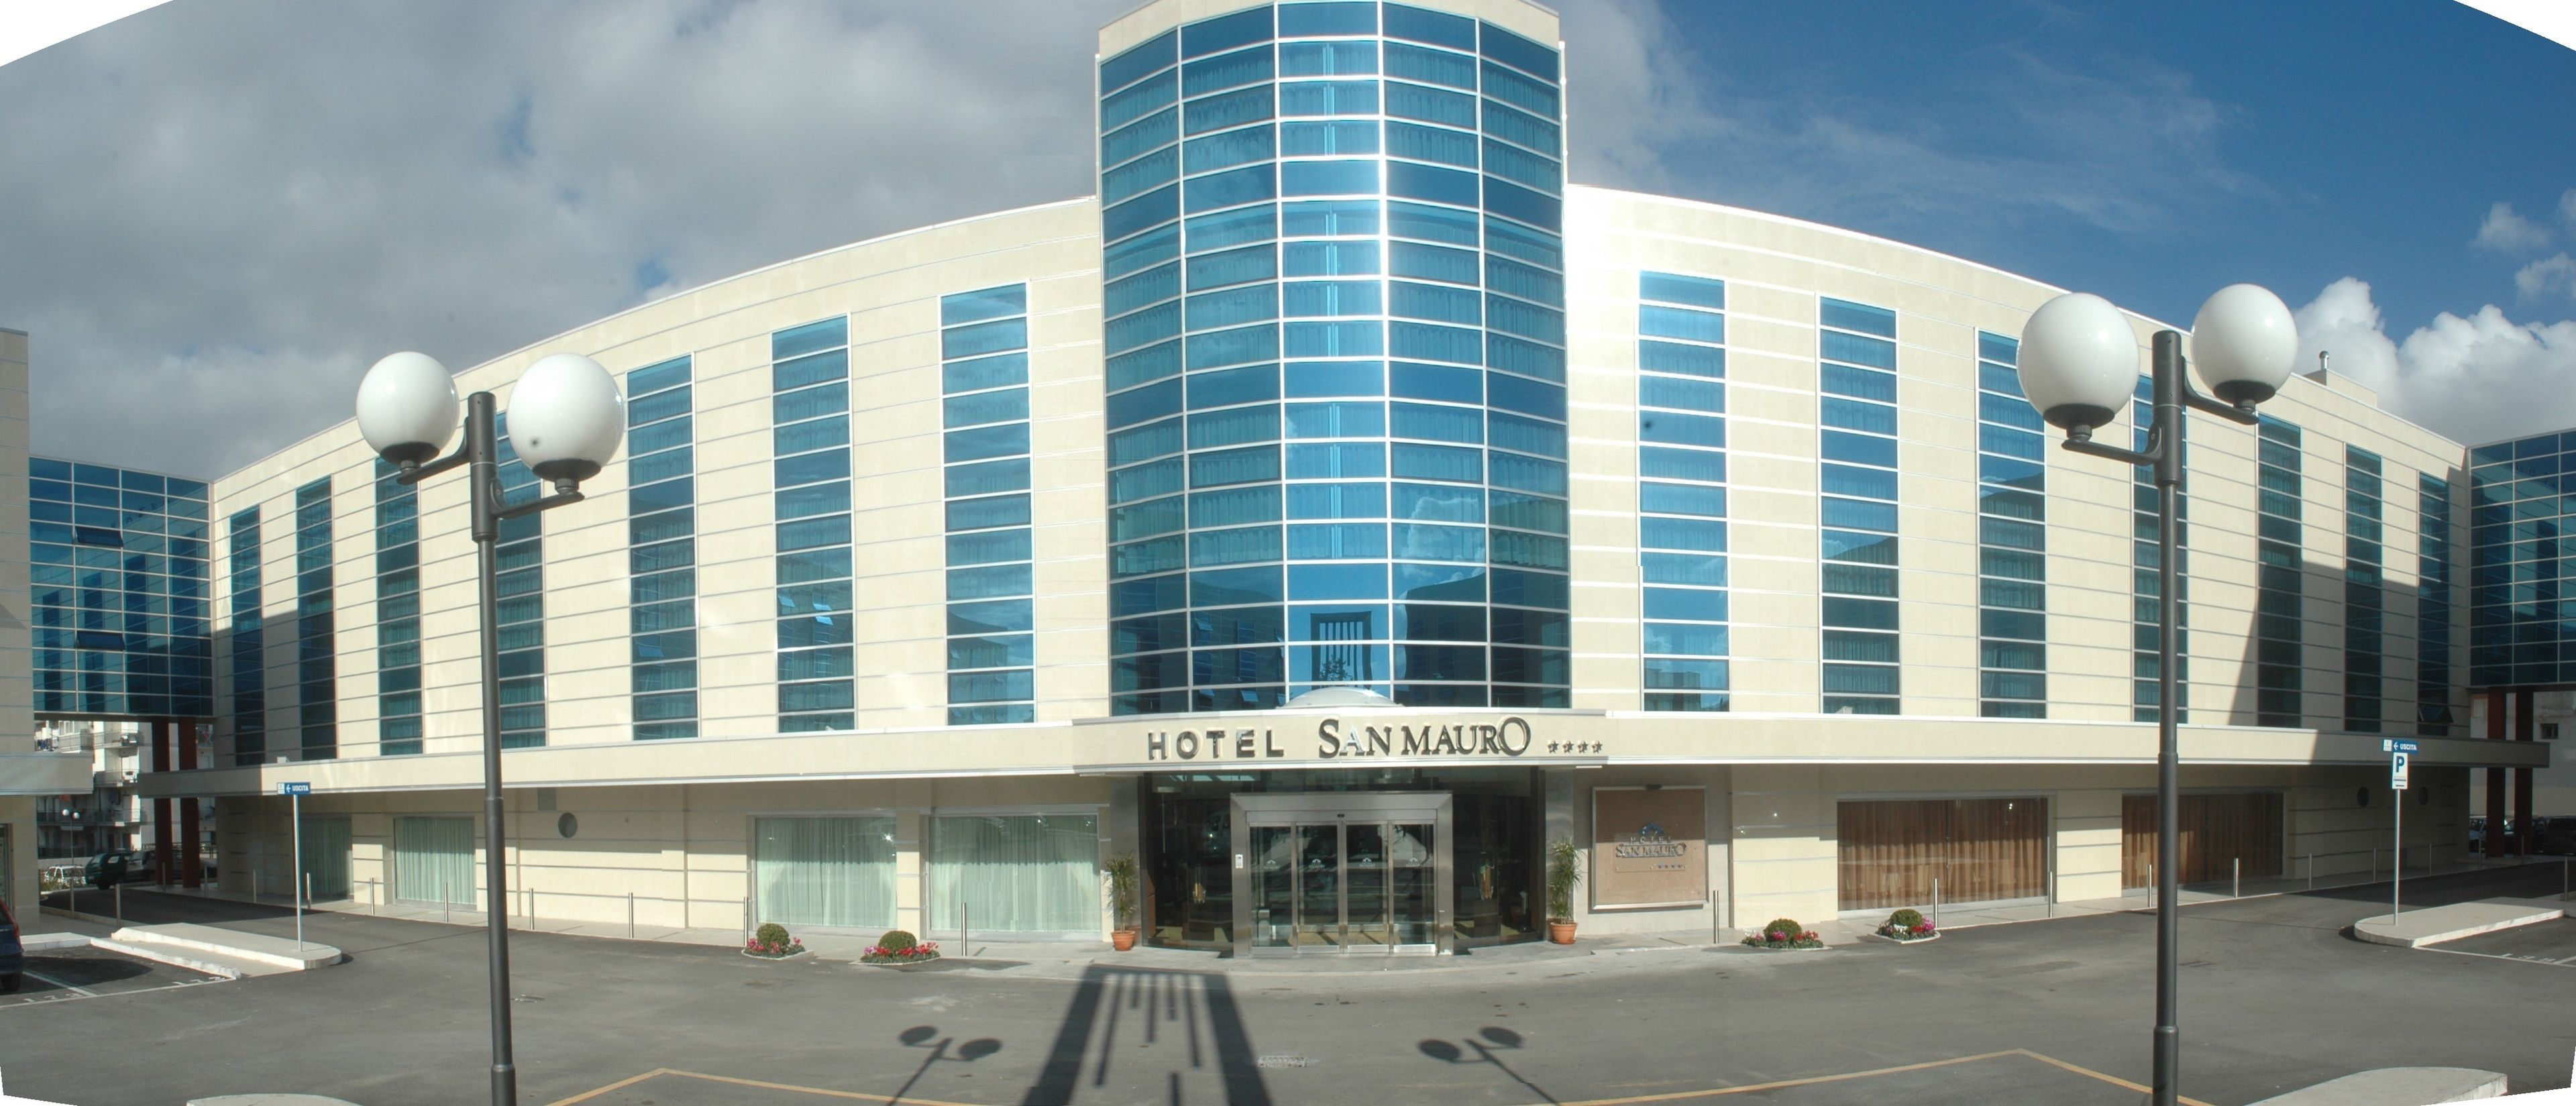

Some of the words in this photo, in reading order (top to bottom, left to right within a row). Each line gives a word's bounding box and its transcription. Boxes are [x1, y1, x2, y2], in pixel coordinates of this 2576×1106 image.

[1148, 729, 1284, 760] HOTEL
[1318, 716, 1393, 759] SAN
[1401, 715, 1532, 757] MAURO
[2396, 756, 2405, 773] P
